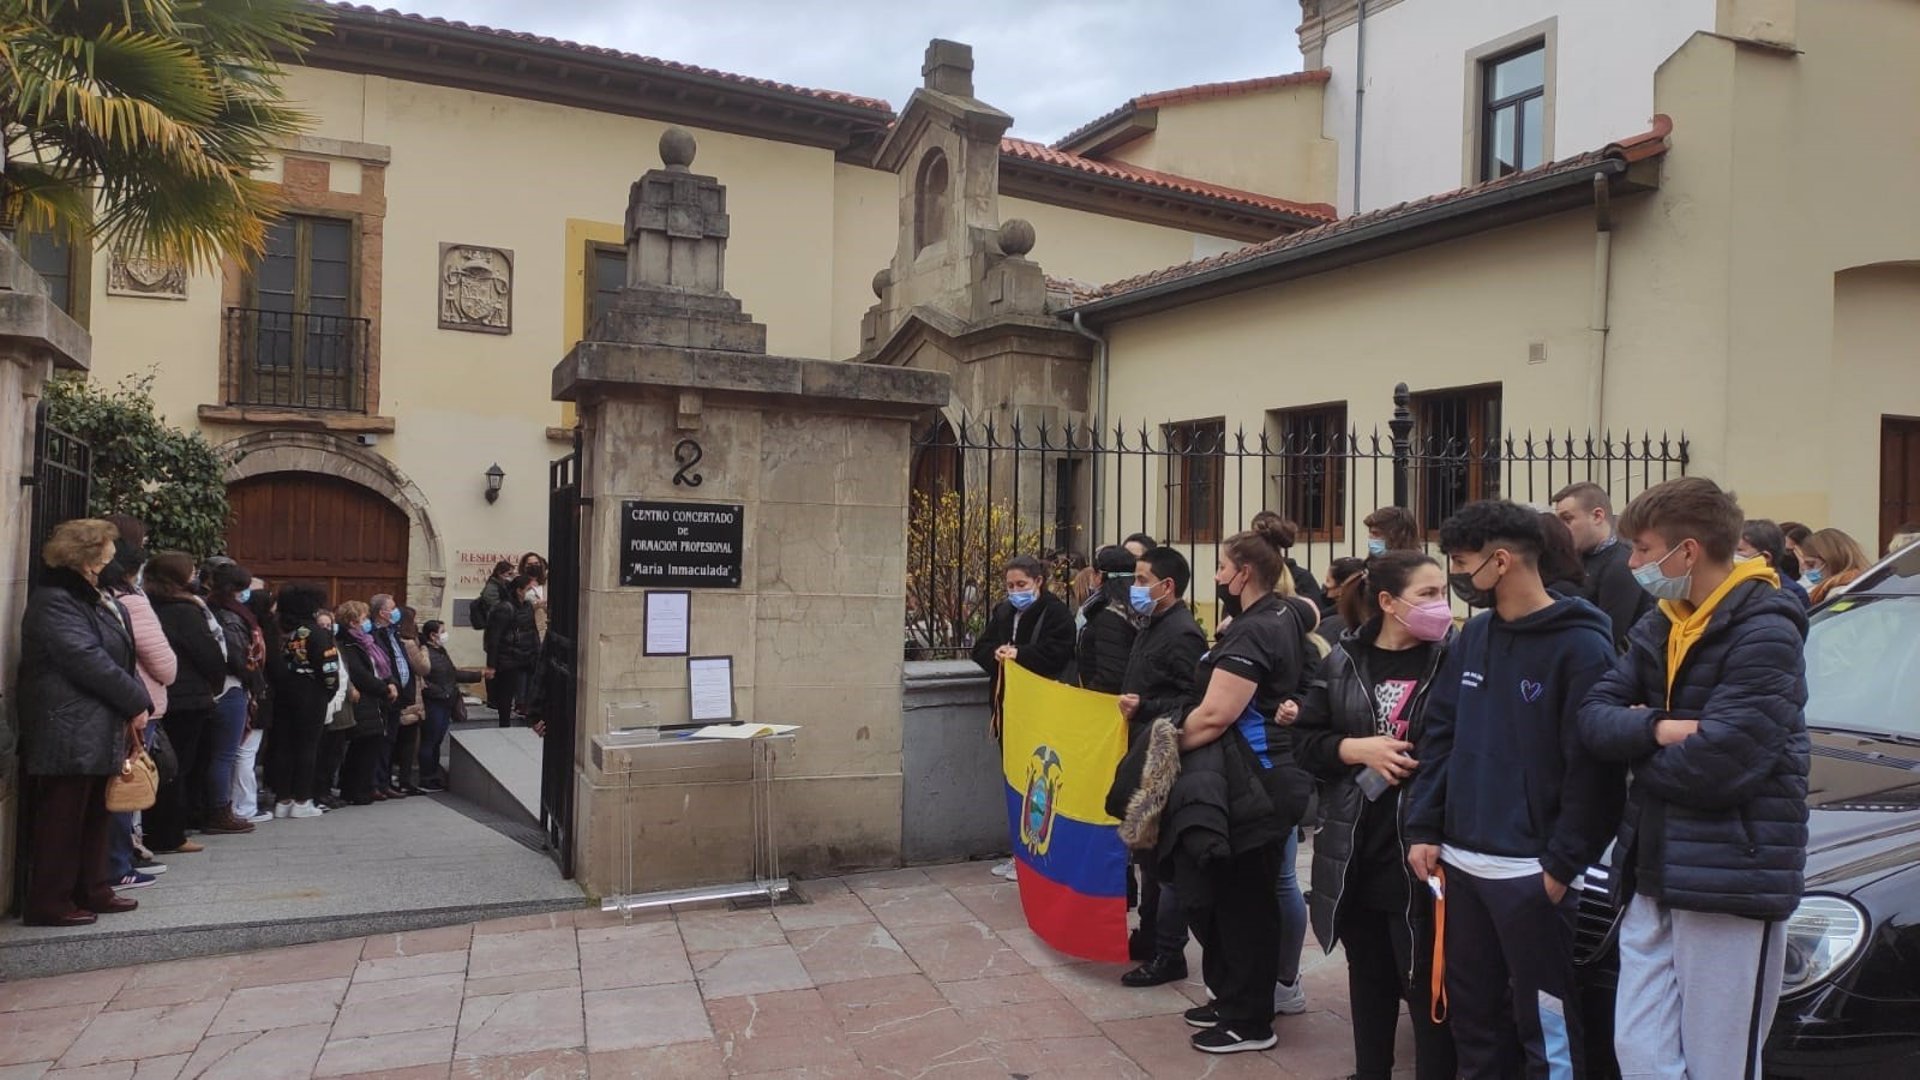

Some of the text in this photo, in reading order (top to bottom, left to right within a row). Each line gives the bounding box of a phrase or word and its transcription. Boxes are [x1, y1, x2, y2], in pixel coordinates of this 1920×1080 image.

[673, 439, 702, 487] 2
[631, 509, 733, 524] CENTRO CONCERTADO
[677, 527, 689, 536] DE
[630, 539, 733, 553] FORMACION PROFESIONAL
